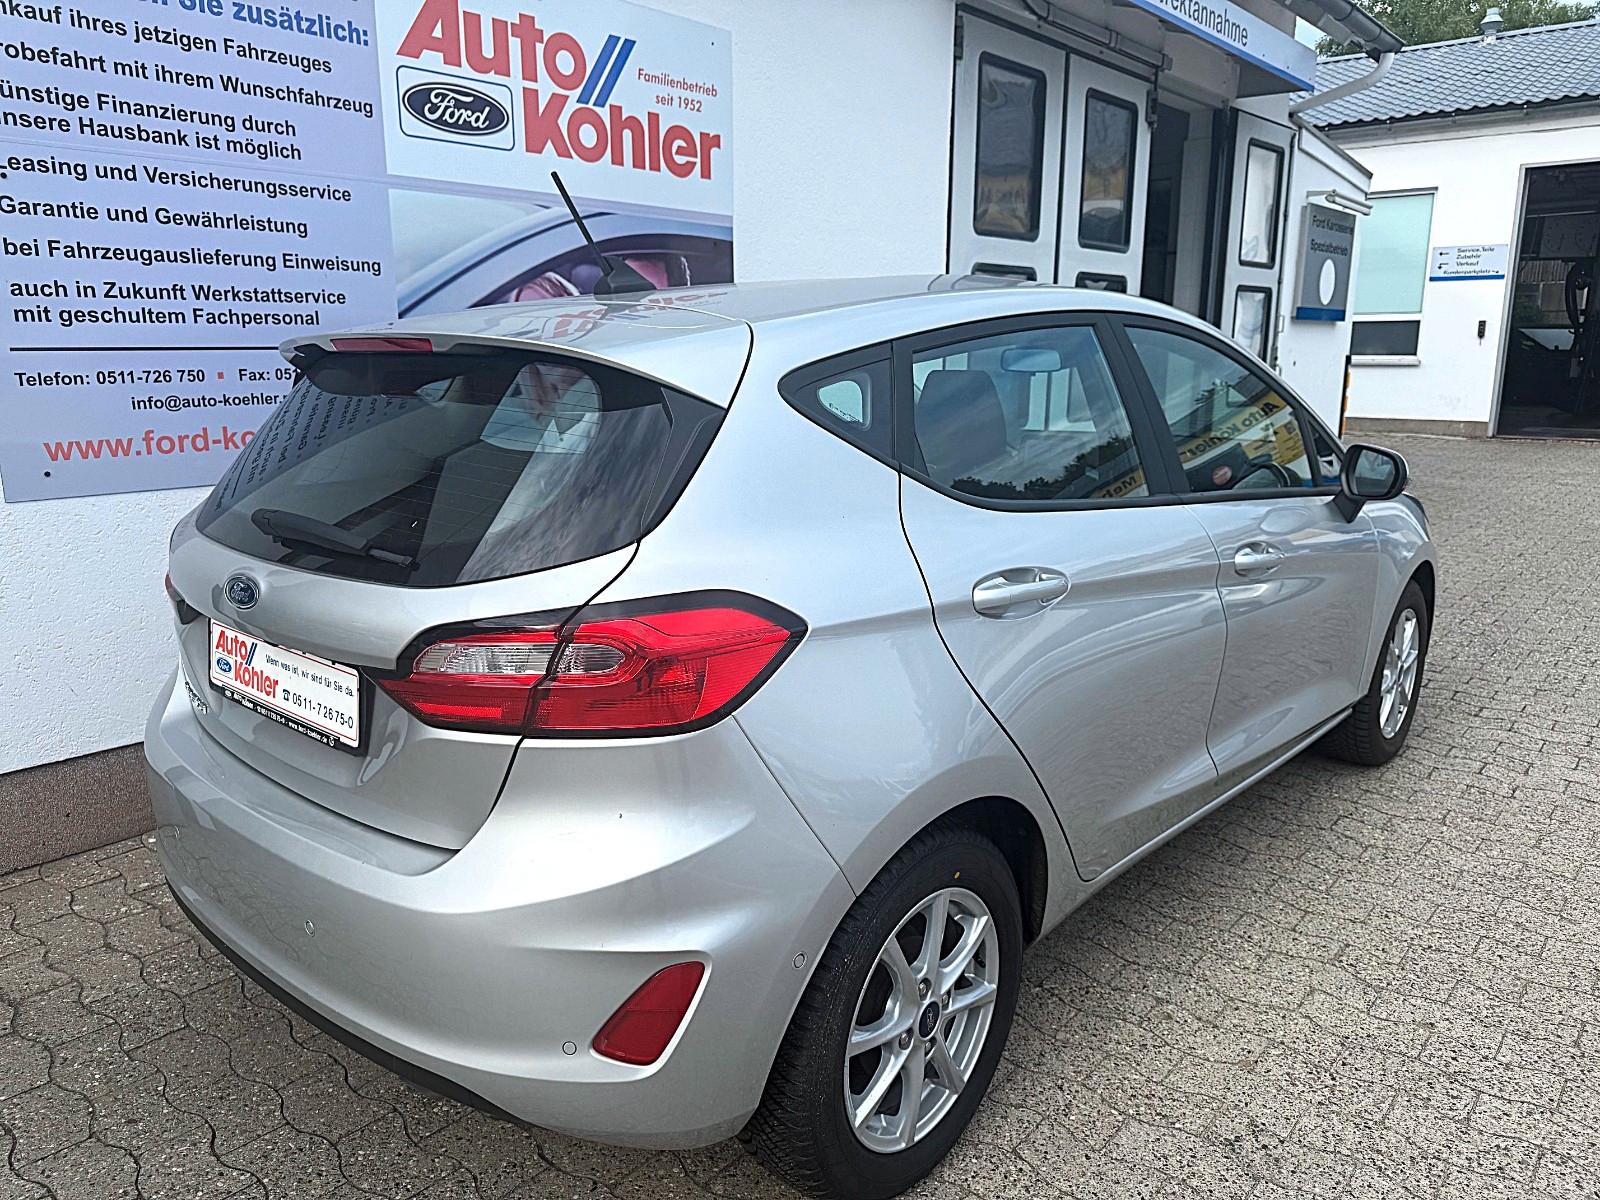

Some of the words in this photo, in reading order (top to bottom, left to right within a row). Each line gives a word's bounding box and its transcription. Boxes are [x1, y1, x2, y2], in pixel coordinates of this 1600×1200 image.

[69, 8, 127, 36] ihres
[134, 21, 217, 52] jetzigen
[223, 38, 332, 73] Fahrzeuges
[232, 2, 369, 46] zusätzlich:
[397, 0, 586, 91] Auto
[0, 41, 106, 73] obefahrt
[113, 60, 149, 79] mit
[155, 64, 214, 89] ihrem
[219, 74, 374, 118] Wunschfahrzeug
[638, 68, 718, 98] Familienbetrieb
[97, 93, 236, 132] Finanzierung
[242, 115, 297, 137] durch
[423, 88, 490, 129] Ford
[655, 93, 674, 107] seit
[677, 96, 703, 113] 1952
[0, 111, 71, 132] nsere
[78, 116, 190, 147] Hausbank
[195, 131, 220, 151] ist
[226, 138, 302, 161] möglich
[95, 163, 138, 182] und
[144, 166, 352, 202] Versicherungsservice
[0, 195, 98, 220] Garantie
[106, 206, 148, 223] und
[155, 208, 308, 238] Gewährleistung
[3, 238, 40, 257] bei
[48, 240, 278, 271] Fahrzeugauslieferung
[283, 253, 382, 276] Einweisung
[10, 280, 68, 298] auch
[76, 281, 97, 298] in
[103, 281, 187, 301] Zukunft
[191, 284, 346, 305] Werkstattservice
[13, 305, 52, 323] mit
[58, 306, 186, 327] geschultem
[193, 309, 320, 328] Fachpersonal
[14, 371, 91, 387] Telefon:
[96, 370, 173, 385] 0511-726
[177, 369, 206, 383] 750
[238, 368, 271, 381] Fax:
[215, 629, 248, 659] Auto
[218, 659, 231, 672] Ford
[266, 654, 280, 667] Wenn
[280, 661, 291, 672] was
[301, 668, 309, 680] wir
[311, 672, 322, 684] sind
[324, 676, 332, 688] für
[333, 680, 343, 693] Sie
